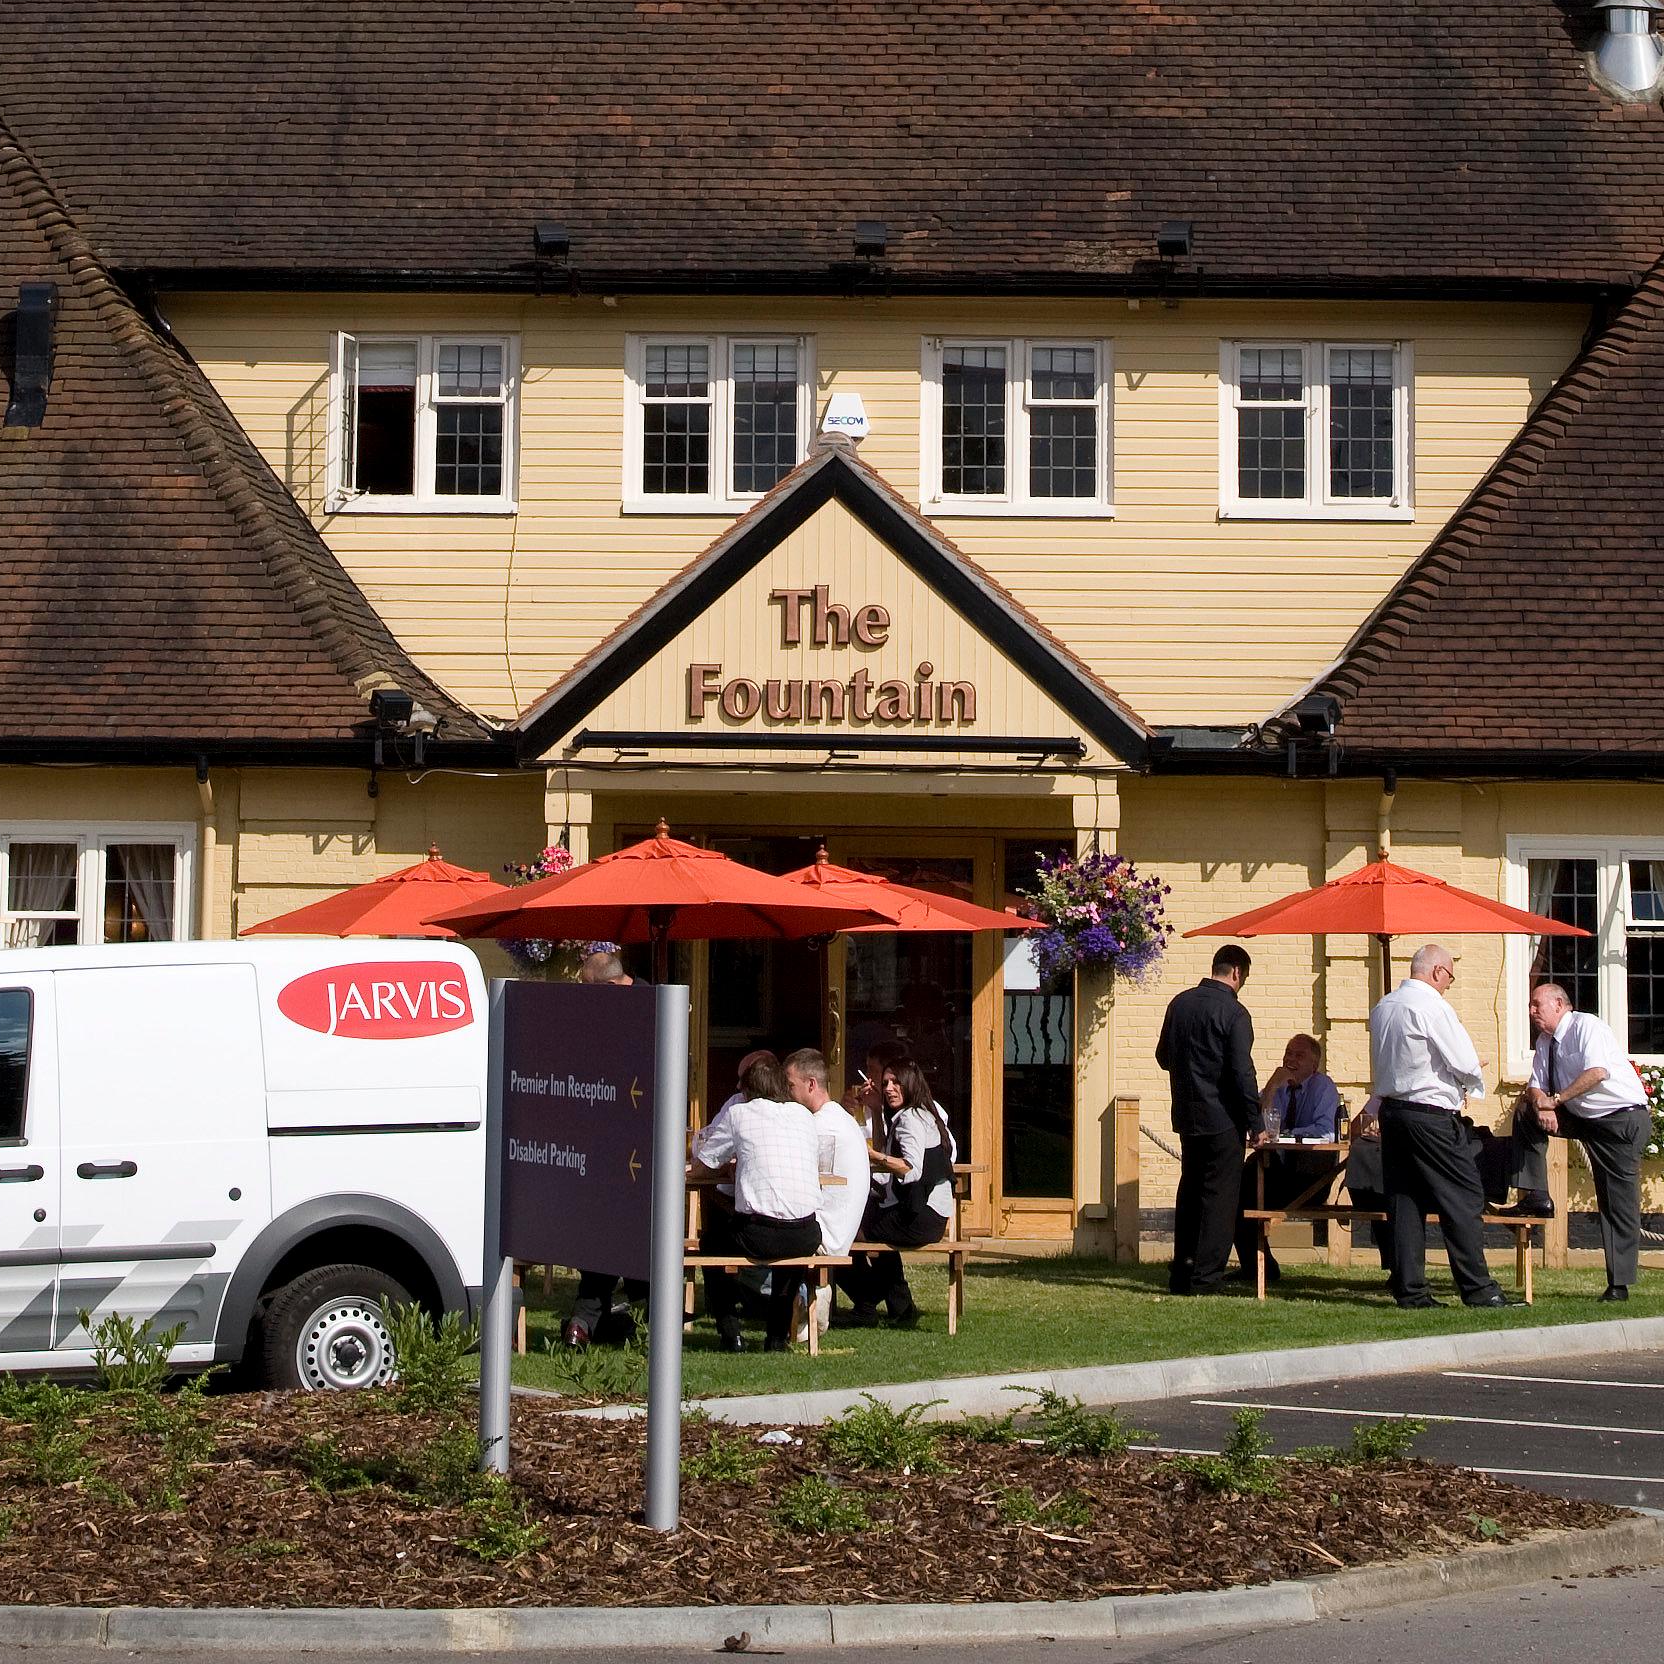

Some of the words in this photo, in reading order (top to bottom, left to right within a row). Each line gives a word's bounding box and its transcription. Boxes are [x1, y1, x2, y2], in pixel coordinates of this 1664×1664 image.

[827, 416, 864, 425] SECOM
[770, 584, 891, 646] The
[688, 661, 977, 722] Fountain
[324, 980, 467, 1036] JARVIS
[510, 1070, 549, 1095] Premier
[550, 1073, 566, 1097] Inn
[567, 1074, 617, 1107] Reception
[508, 1138, 548, 1165] Disabled
[550, 1142, 587, 1177] Parking
